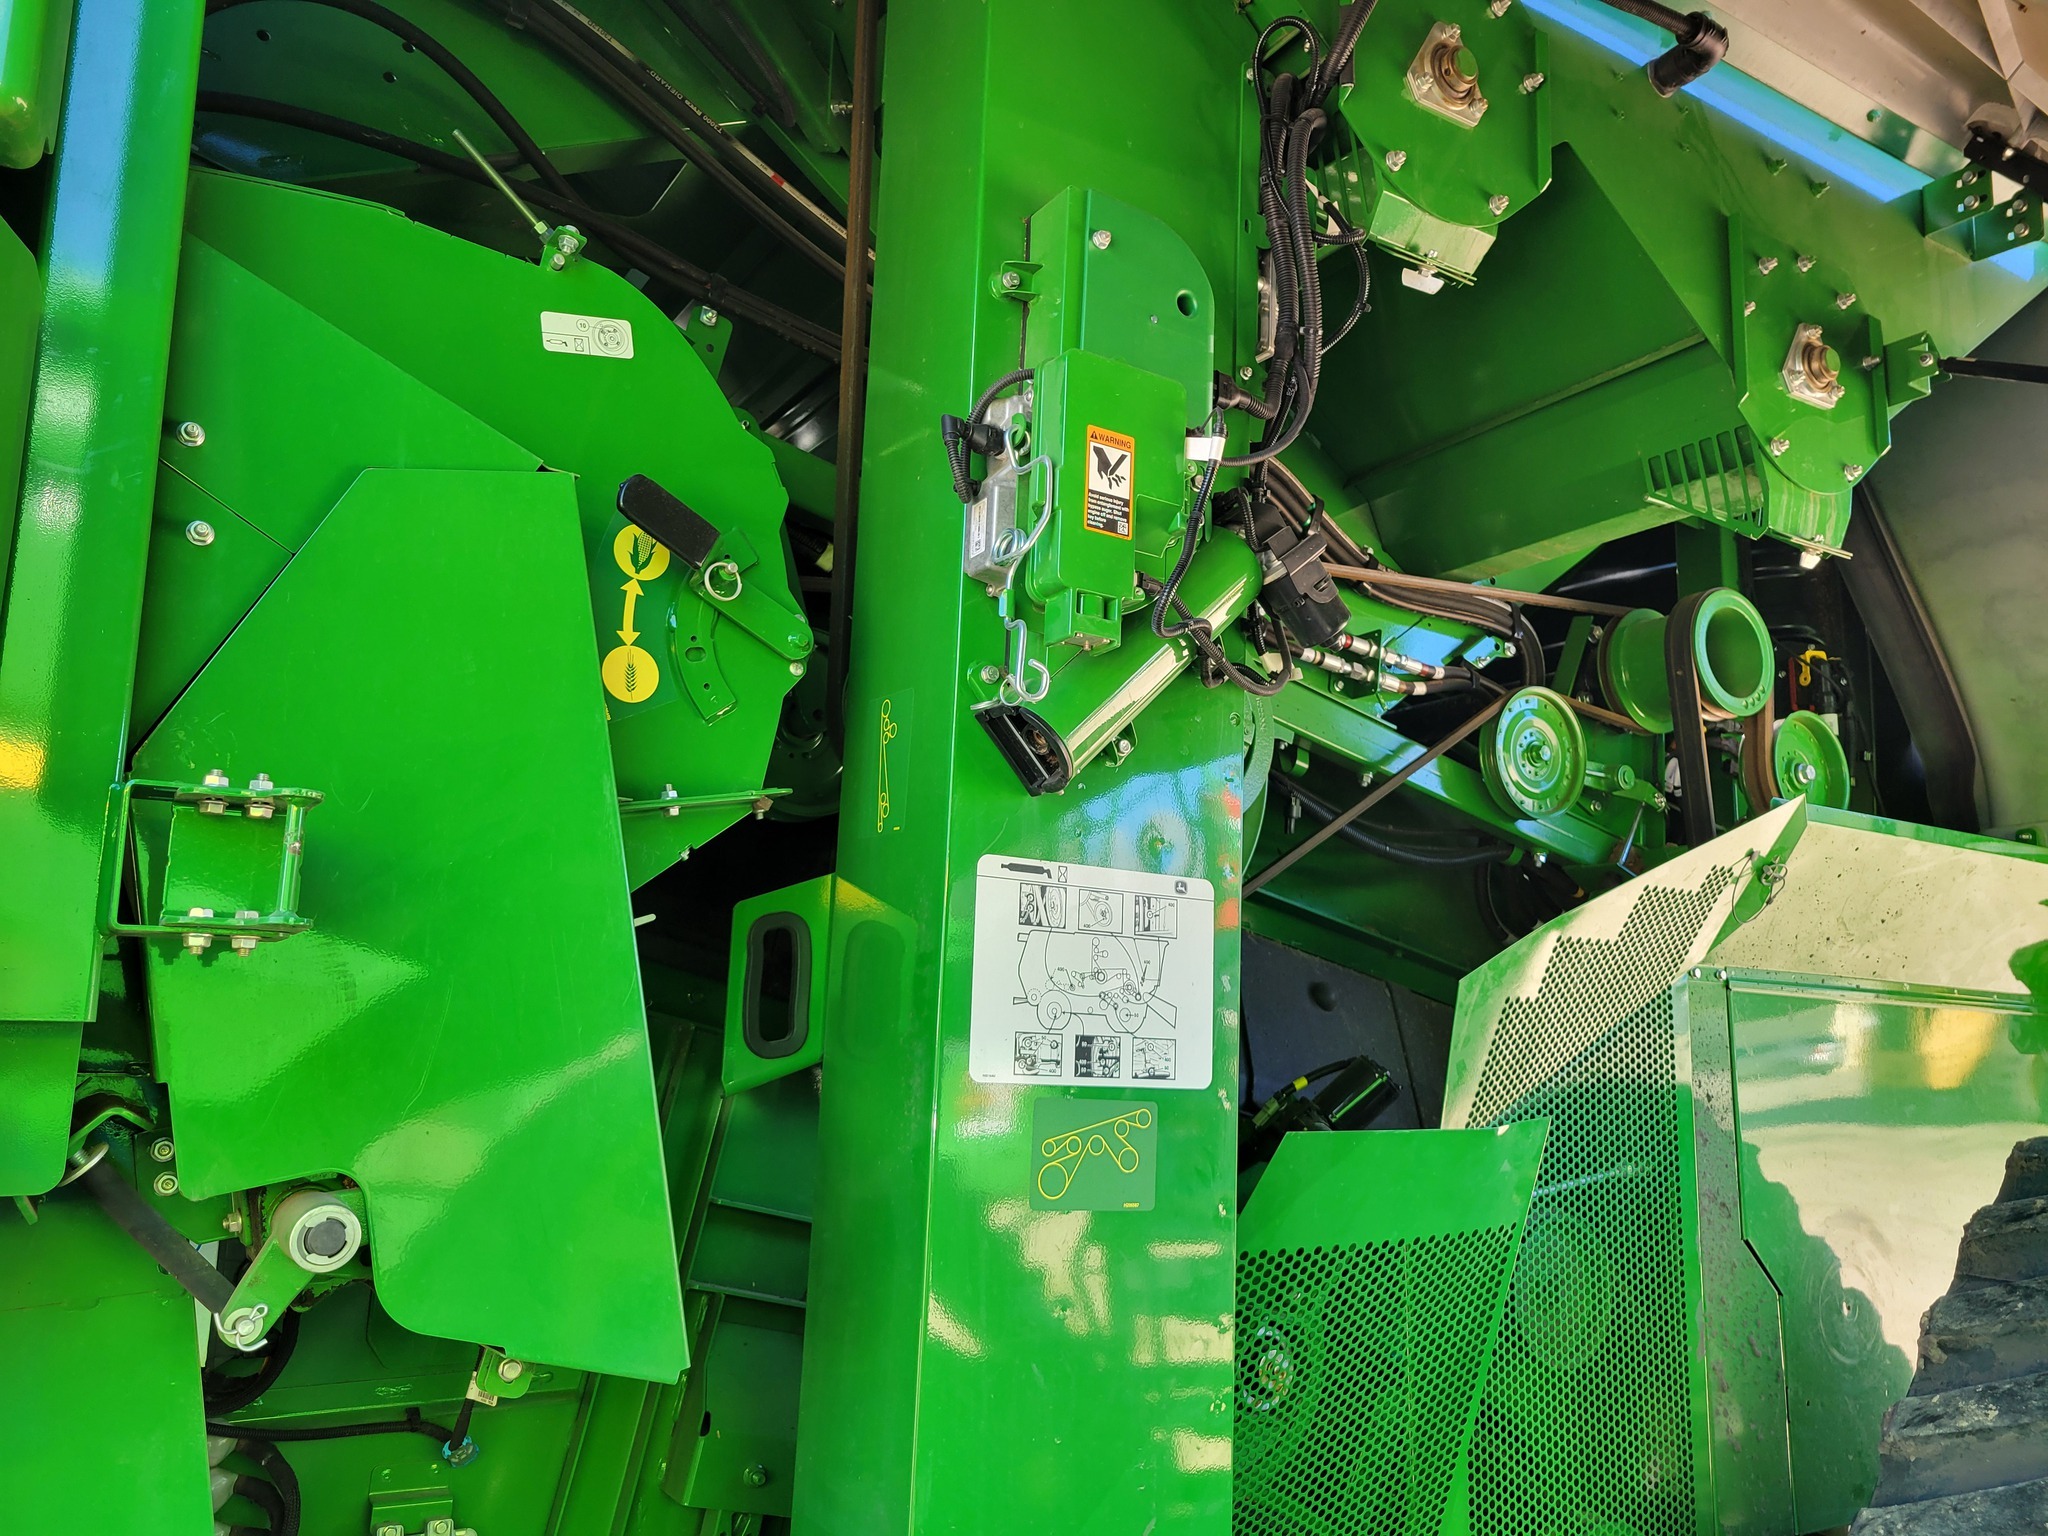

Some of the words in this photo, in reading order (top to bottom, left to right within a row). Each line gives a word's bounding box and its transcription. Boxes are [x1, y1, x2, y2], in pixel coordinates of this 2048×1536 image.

[1098, 433, 1132, 449] WARNING
[1088, 491, 1100, 499] Avoid
[1099, 495, 1113, 503] serious
[1113, 498, 1124, 507] injury
[1097, 500, 1122, 510] entanglement
[1087, 509, 1101, 517] engine
